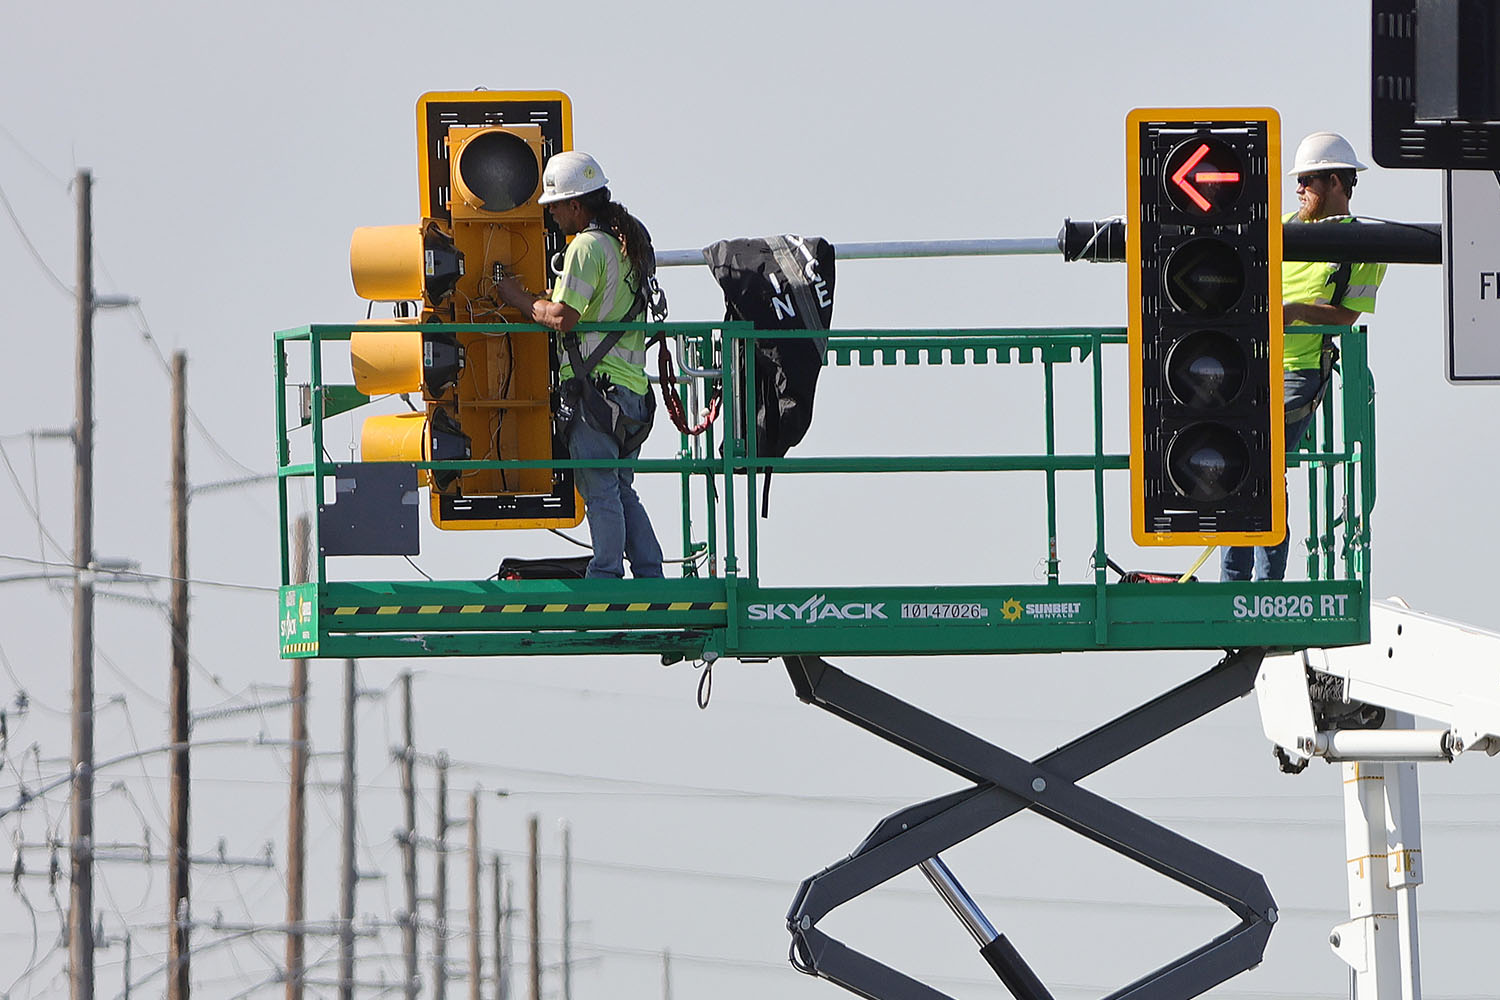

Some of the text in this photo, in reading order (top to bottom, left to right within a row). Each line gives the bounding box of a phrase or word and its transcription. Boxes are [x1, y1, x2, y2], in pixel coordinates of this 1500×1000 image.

[747, 593, 889, 623] SKYJACK
[903, 603, 980, 618] 10147026
[1025, 602, 1081, 615] SUNBELT
[1233, 594, 1348, 618] SJ6826 RT
